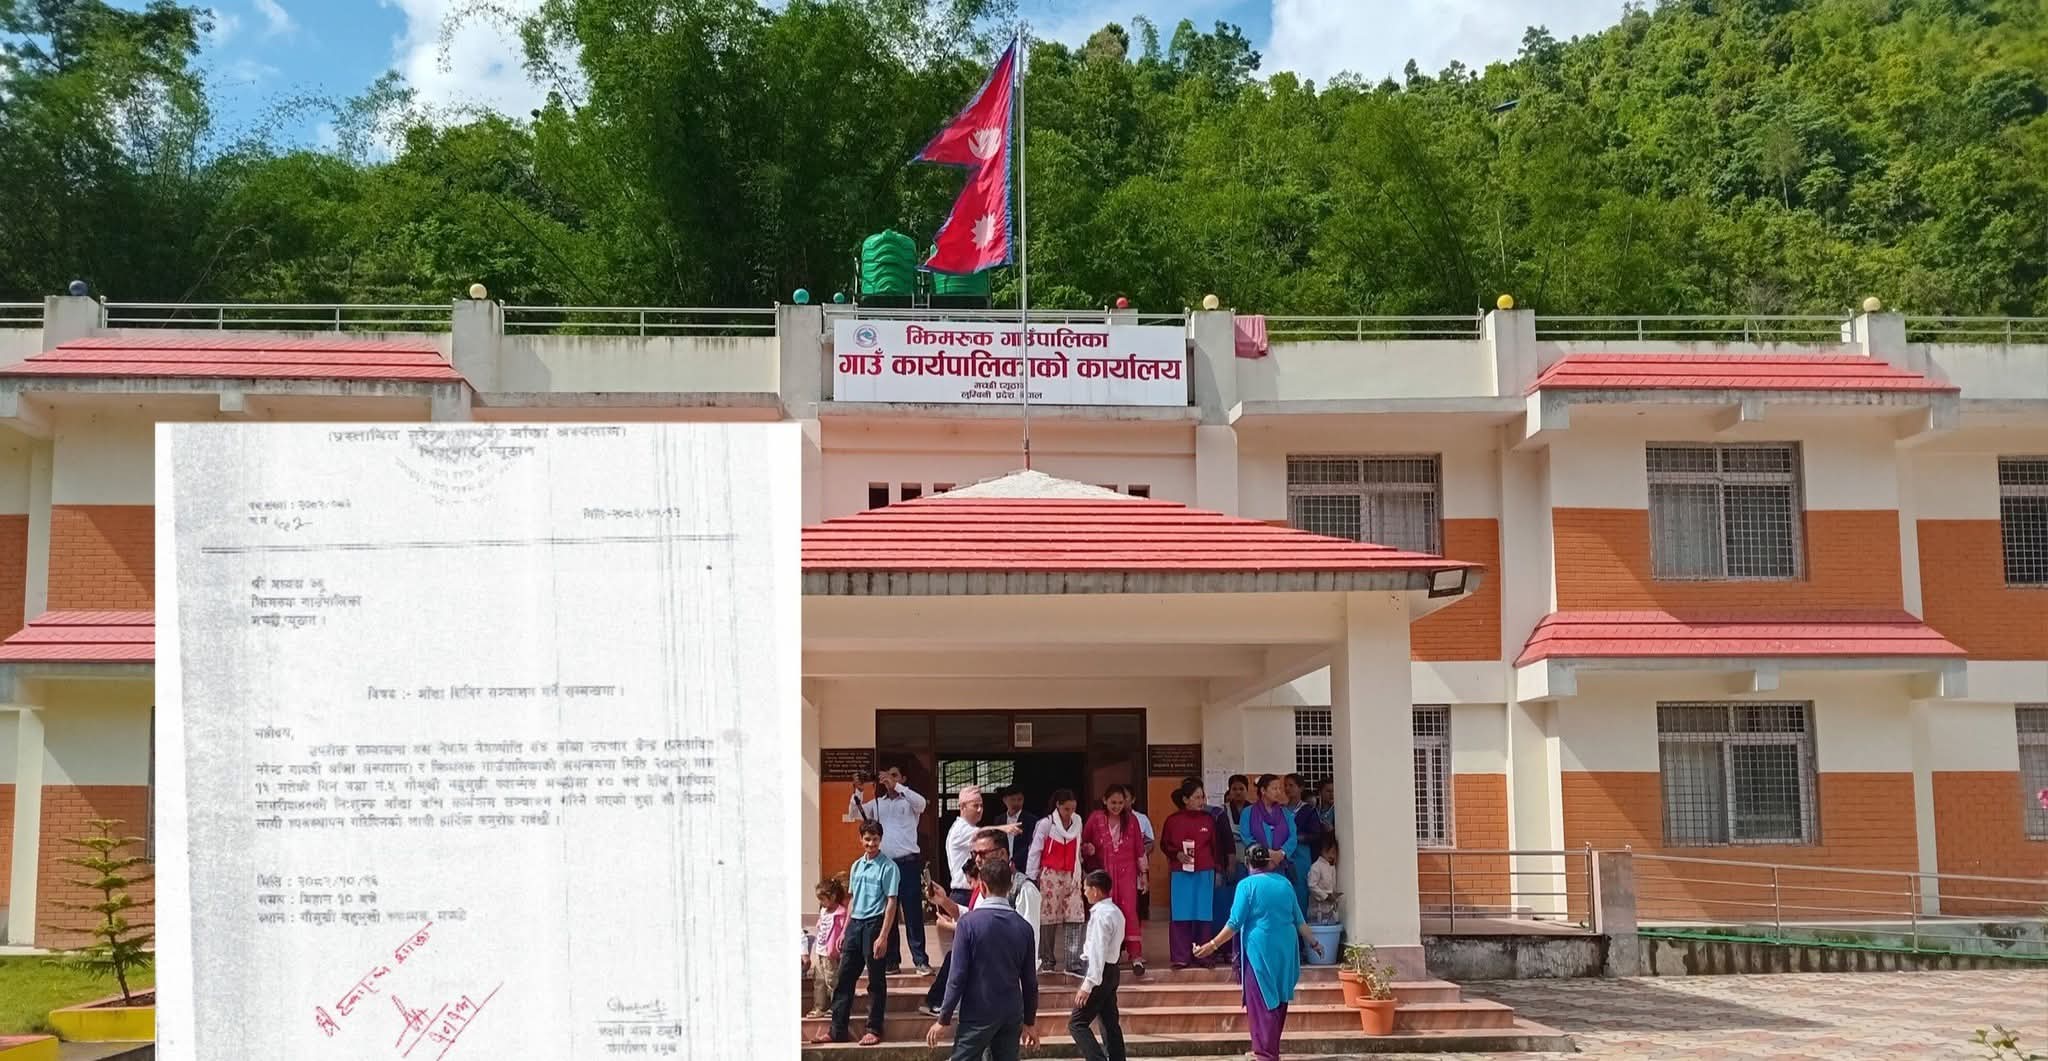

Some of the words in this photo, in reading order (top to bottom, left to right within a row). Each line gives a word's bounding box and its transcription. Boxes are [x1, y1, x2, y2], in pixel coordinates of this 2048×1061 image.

[1000, 327, 1109, 349] गाउँपालिका
[839, 348, 884, 377] गाउँ
[892, 349, 1069, 379] कार्यपालिकाको
[1077, 353, 1182, 381] कार्यालय
[996, 390, 1015, 400] प्रदेश
